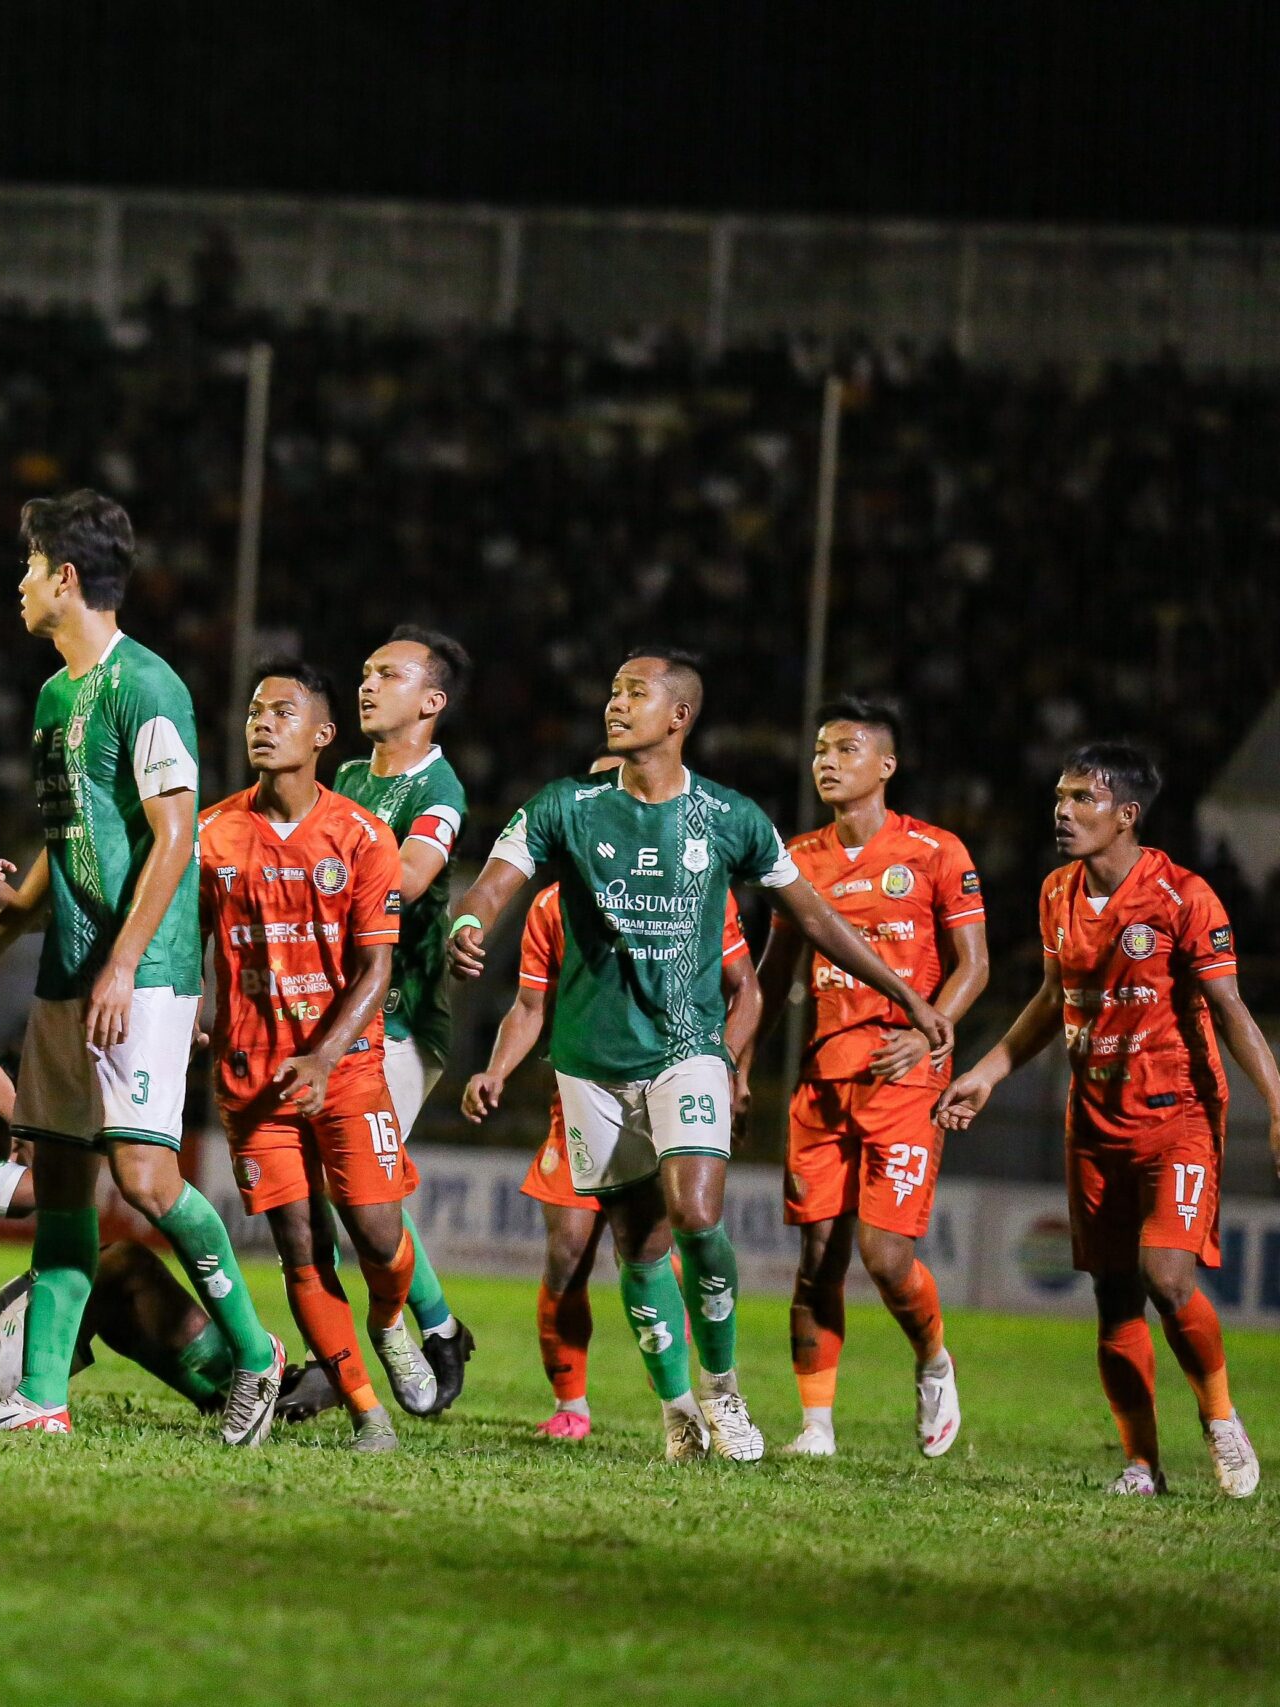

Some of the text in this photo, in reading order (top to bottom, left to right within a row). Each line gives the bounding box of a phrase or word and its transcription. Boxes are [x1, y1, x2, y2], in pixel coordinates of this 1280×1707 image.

[216, 866, 237, 875] TROPS
[630, 868, 664, 877] PSTORE
[619, 918, 694, 931] PDAM TIRTANADI
[281, 975, 307, 986] BANK
[282, 983, 332, 997] INDONESIA
[131, 1070, 150, 1105] 3
[679, 1094, 716, 1125] 29
[363, 1111, 398, 1154] 16
[886, 1143, 928, 1186] 23
[1173, 1163, 1205, 1204] 17
